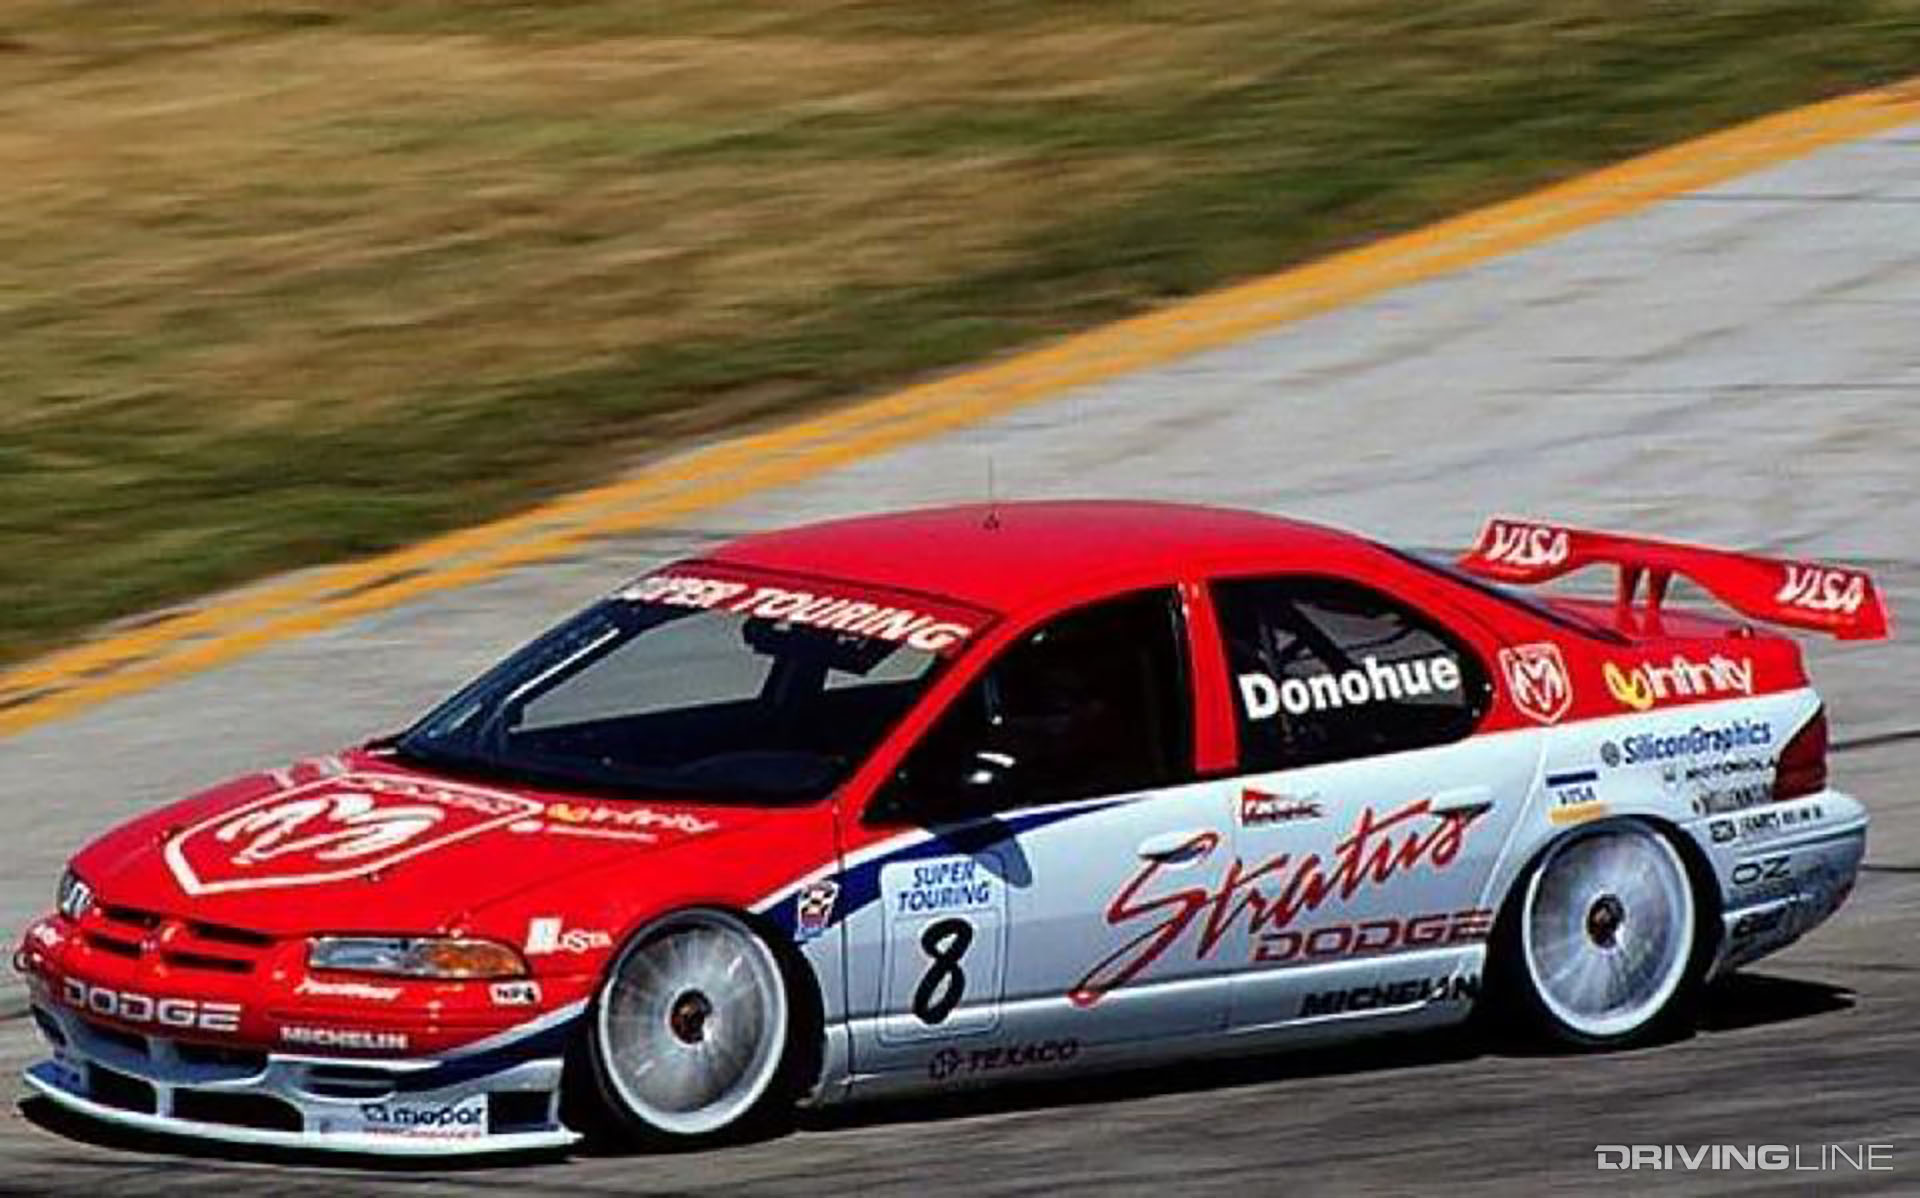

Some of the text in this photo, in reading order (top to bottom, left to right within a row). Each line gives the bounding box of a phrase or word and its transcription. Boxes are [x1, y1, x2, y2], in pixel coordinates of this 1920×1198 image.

[1486, 525, 1570, 566] VISA
[1775, 565, 1866, 614] VISA
[730, 586, 972, 650] TOURING
[1238, 655, 1462, 720] Donohue
[899, 882, 990, 913] TOURING
[913, 861, 976, 889] SUPER
[1069, 799, 1478, 1008] Stratus
[1253, 908, 1493, 962] DODGE
[911, 916, 974, 1025] 8
[63, 975, 242, 1032] DODGE
[1299, 972, 1480, 1018] MICHELIN
[279, 1025, 410, 1050] MICHELIN
[970, 1036, 1080, 1072] TEXACO
[393, 1105, 482, 1128] mopar
